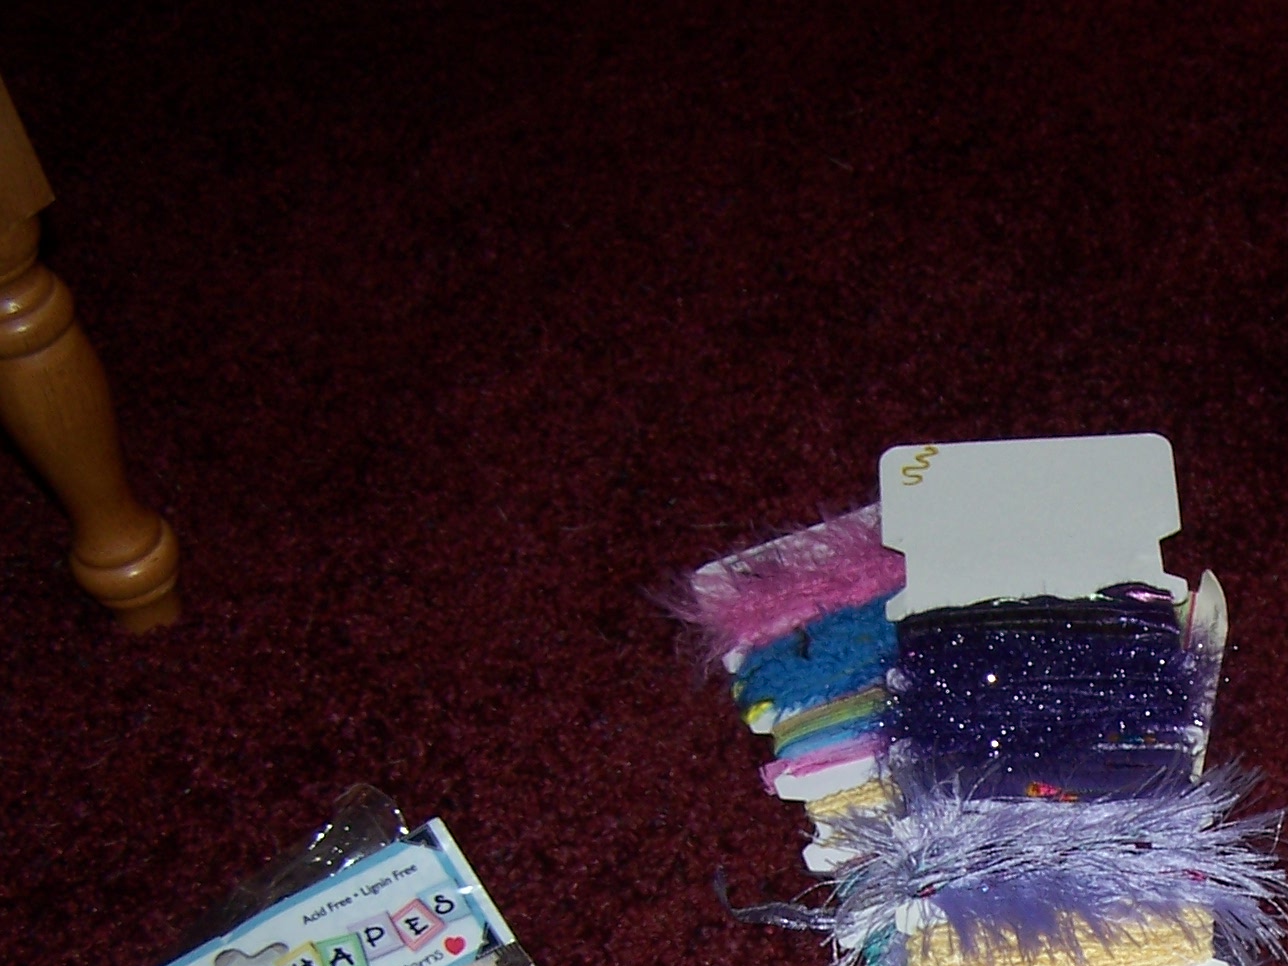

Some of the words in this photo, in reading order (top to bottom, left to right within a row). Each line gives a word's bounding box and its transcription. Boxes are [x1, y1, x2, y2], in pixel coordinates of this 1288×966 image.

[302, 906, 328, 925] Acid
[327, 896, 353, 913] Free
[360, 875, 393, 896] Lignin
[392, 863, 418, 881] Free
